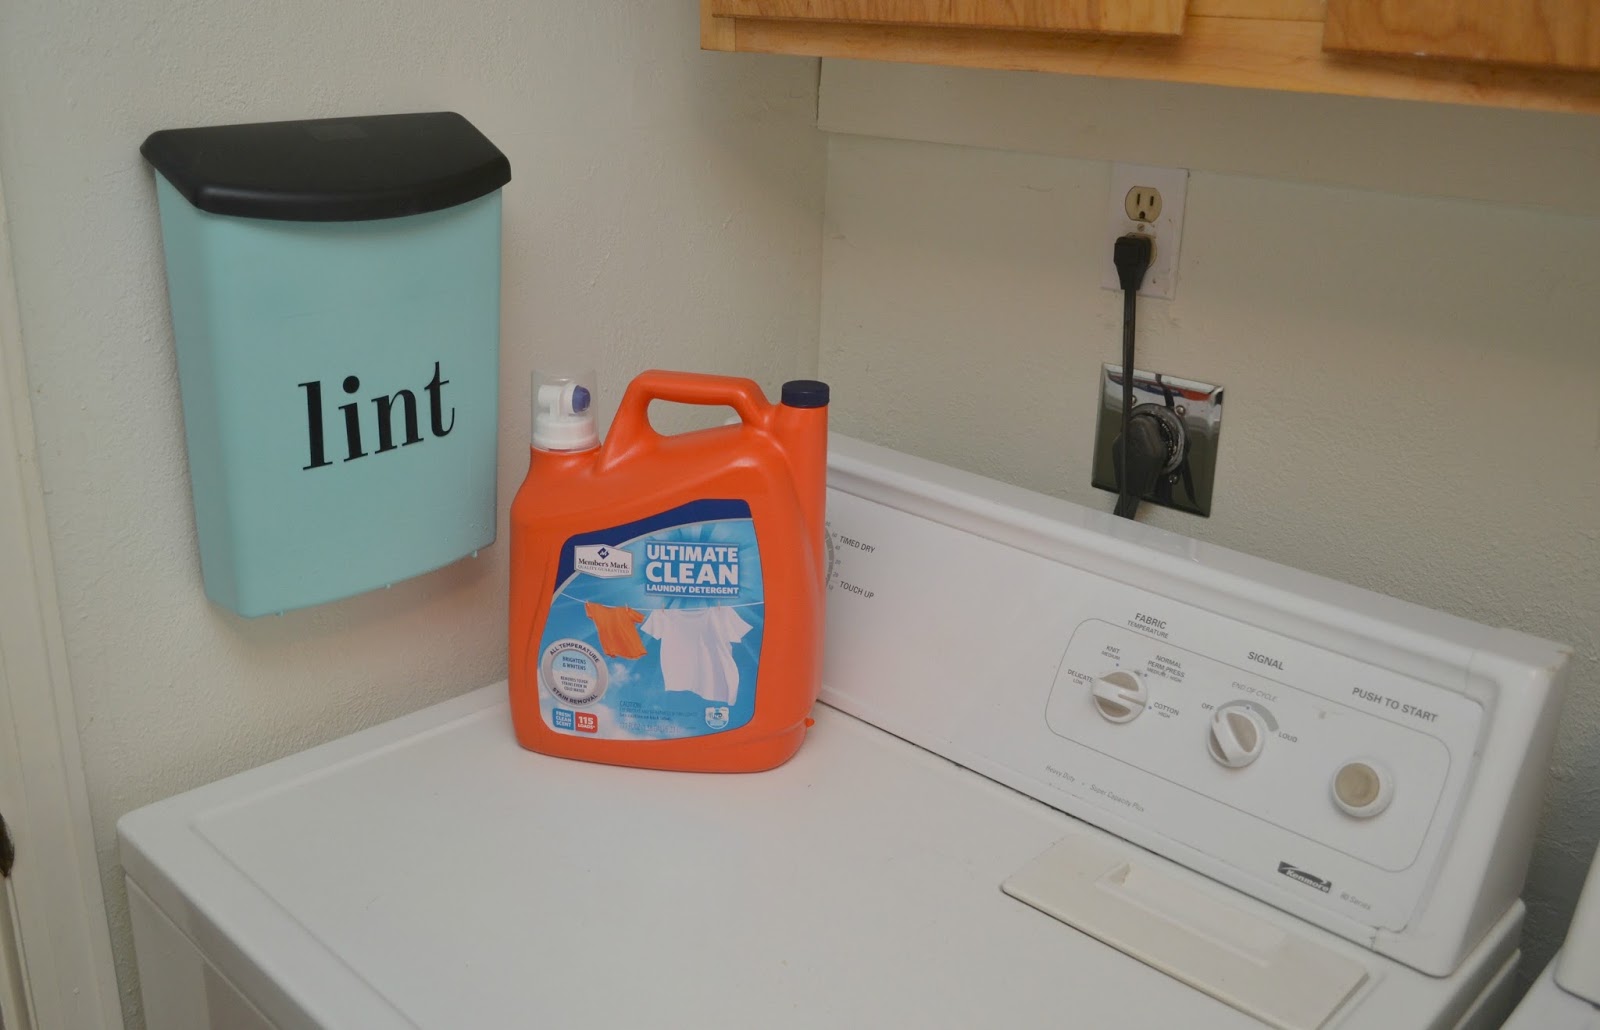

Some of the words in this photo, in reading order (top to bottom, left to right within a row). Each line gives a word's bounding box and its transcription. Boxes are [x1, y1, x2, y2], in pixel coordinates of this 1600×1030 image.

[298, 361, 455, 470] lint
[646, 544, 739, 563] ULTIMATE
[840, 535, 861, 549] TIMED
[860, 543, 876, 554] DRY
[578, 558, 609, 567] Member's
[645, 561, 739, 585] CLEAN
[646, 584, 687, 593] LAUNDRY
[688, 586, 739, 595] DETERGENT
[839, 580, 864, 596] TOUCH
[863, 590, 875, 599] UP
[1127, 620, 1169, 639] TEMPERATURE
[1135, 612, 1167, 630] FABRIC
[550, 647, 560, 656] ALL
[559, 642, 600, 663] TEMPERATURE
[1106, 645, 1121, 654] KNIT
[562, 656, 587, 664] BRIGHTENS
[567, 663, 587, 671] WHITENS
[1155, 655, 1182, 669] NORMAL
[1247, 651, 1285, 671] SIGNAL
[1067, 669, 1094, 684] DELICATE
[1165, 666, 1185, 678] PRESS
[552, 687, 569, 701] STAIN
[569, 694, 598, 705] REMOVAL
[1231, 681, 1246, 691] END
[1246, 686, 1256, 694] OF
[1255, 690, 1278, 702] CYCLE
[1154, 701, 1180, 716] COTTON
[1201, 702, 1215, 711] OFF
[1352, 687, 1383, 704] PUSH
[1384, 697, 1400, 710] TO
[1401, 704, 1439, 723] START
[578, 716, 594, 725] 115
[1278, 731, 1298, 743] LOUD
[1045, 764, 1062, 776] Heavy
[1062, 772, 1076, 783] Duty
[1089, 784, 1107, 796] Super
[1107, 791, 1132, 807] Capacity
[1131, 801, 1145, 813] Plus
[1285, 869, 1330, 892] Kenmore
